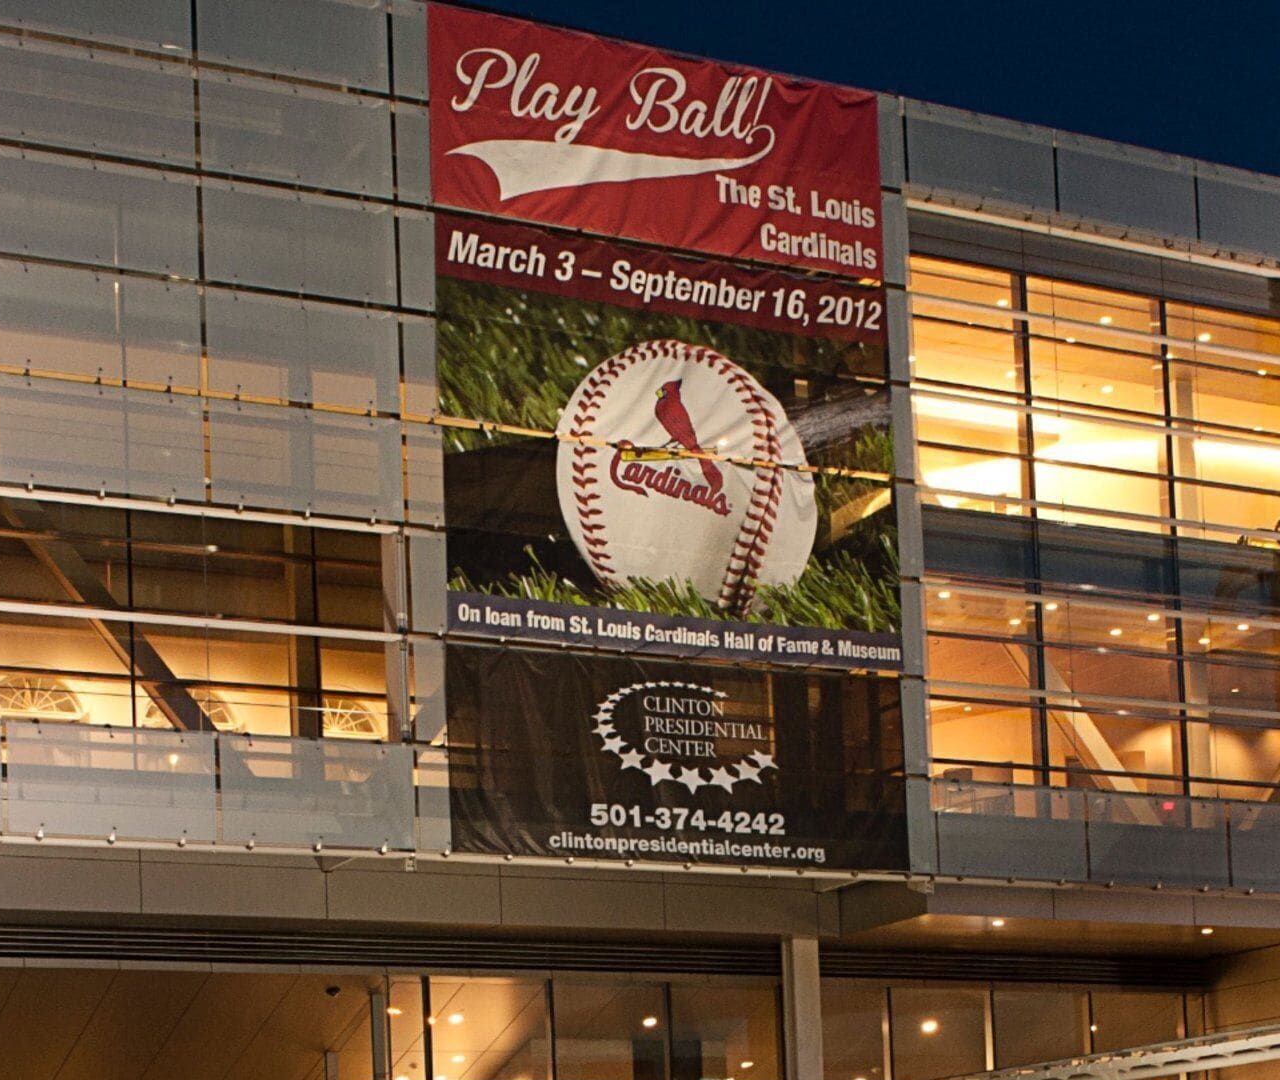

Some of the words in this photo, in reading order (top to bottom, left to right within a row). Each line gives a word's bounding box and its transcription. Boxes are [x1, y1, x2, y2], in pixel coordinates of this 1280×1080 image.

[451, 47, 600, 145] Play
[626, 66, 773, 145] Ball!
[715, 174, 762, 209] The
[767, 185, 802, 215] St.
[810, 190, 876, 228] Louis
[760, 222, 877, 270] Cardinals
[447, 230, 546, 277] March
[554, 250, 576, 282] 3
[609, 259, 766, 313] September
[772, 288, 810, 328] 16,
[816, 294, 882, 331] 2012
[610, 440, 731, 517] Cardinals
[458, 603, 481, 623] On
[486, 607, 521, 628] loan
[527, 610, 565, 632] from
[570, 615, 593, 635] St.
[598, 618, 641, 641] Louis
[645, 624, 720, 648] Cardinals
[724, 631, 754, 651] Hall
[758, 635, 774, 652] of
[777, 636, 819, 655] Fame
[821, 639, 835, 656] &
[838, 639, 901, 662] Museum
[643, 695, 726, 718] CLINTON
[644, 716, 768, 742] PRESIDENTIAL
[644, 737, 717, 759] CENTER
[590, 803, 786, 836] 501-374-4242
[549, 832, 827, 863] clintonpresidentialcenter.org
